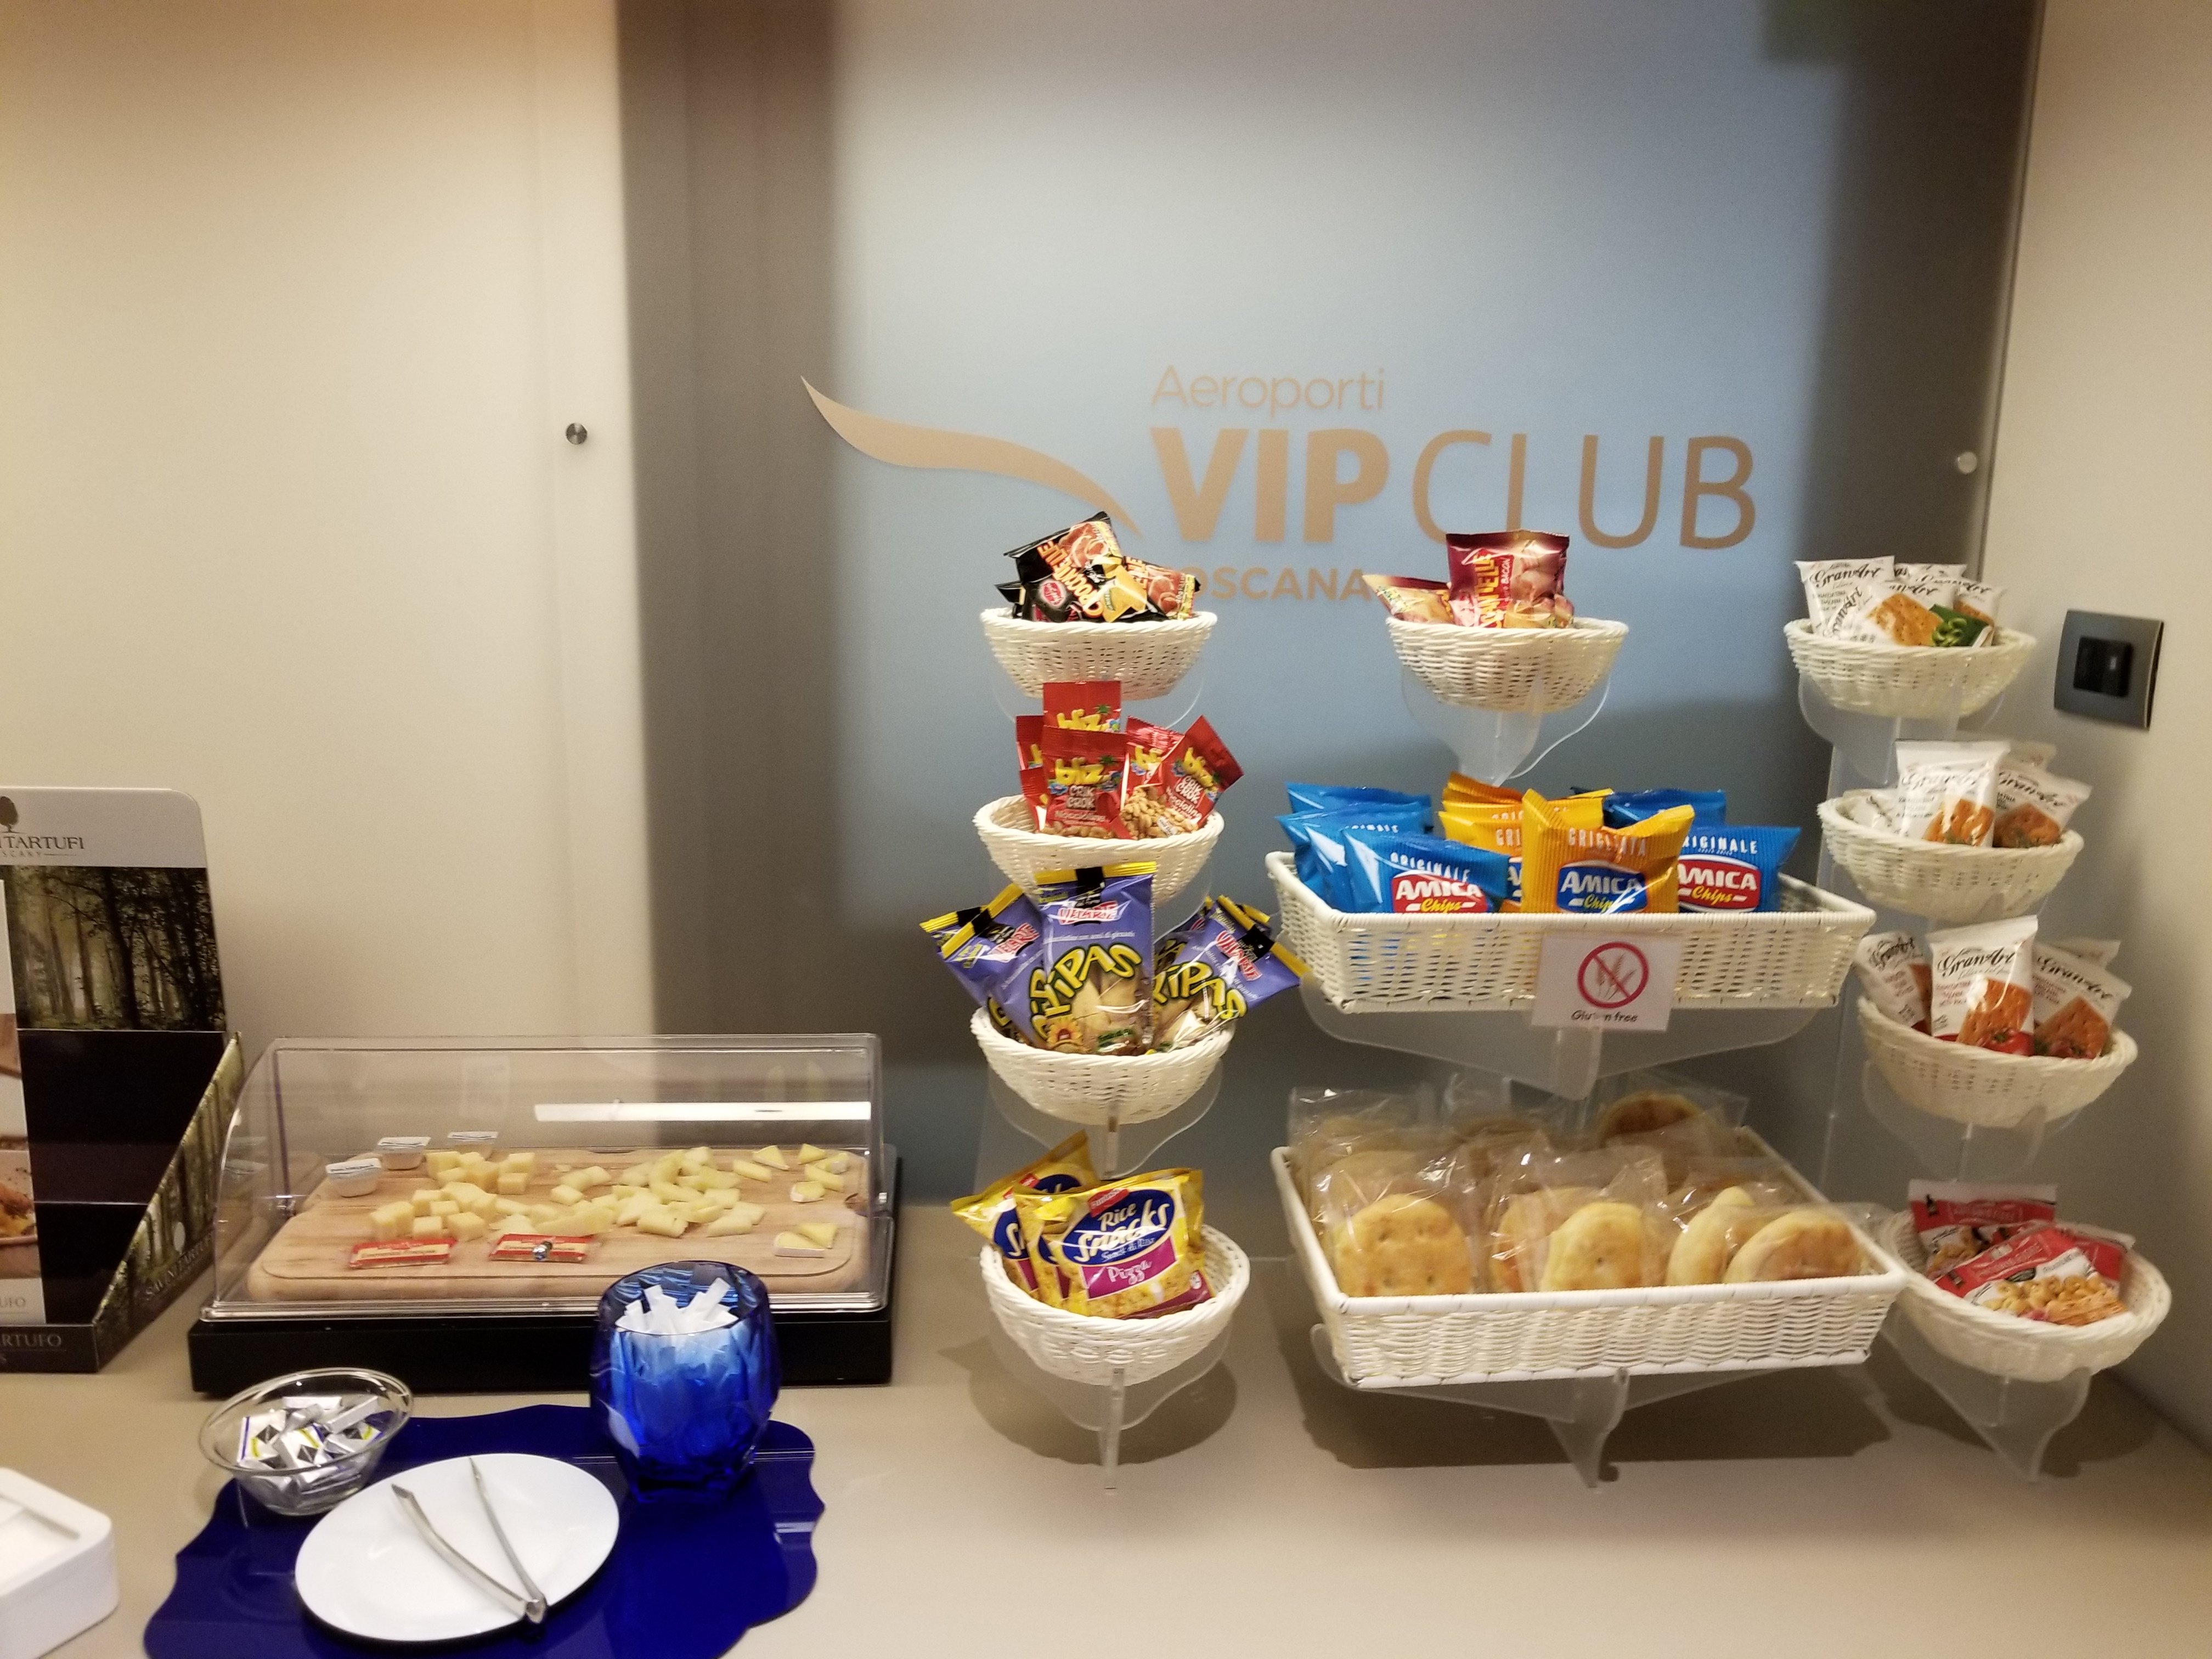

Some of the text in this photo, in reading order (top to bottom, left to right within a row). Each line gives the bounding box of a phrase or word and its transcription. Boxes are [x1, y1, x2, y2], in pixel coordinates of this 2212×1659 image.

[1151, 364, 1385, 419] Aeroporti
[1150, 427, 1756, 549] VIP CLUB
[1174, 565, 1372, 602] OSCANA
[3, 836, 84, 849] TARTUFI
[1681, 835, 1759, 855] RIGINALE
[1391, 851, 1470, 882] ORIGINALE
[1396, 880, 1482, 900] AMICA
[1560, 871, 1645, 894] AMICA
[1420, 898, 1462, 913] Chips
[1583, 894, 1615, 913] Chip
[1691, 885, 1735, 906] Chips
[1571, 1009, 1638, 1023] Glun free
[1098, 1203, 1137, 1232] Rice
[1073, 1199, 1170, 1262] Snacks
[1105, 1260, 1153, 1285] Pizza
[2, 1334, 61, 1347] RTUFO
